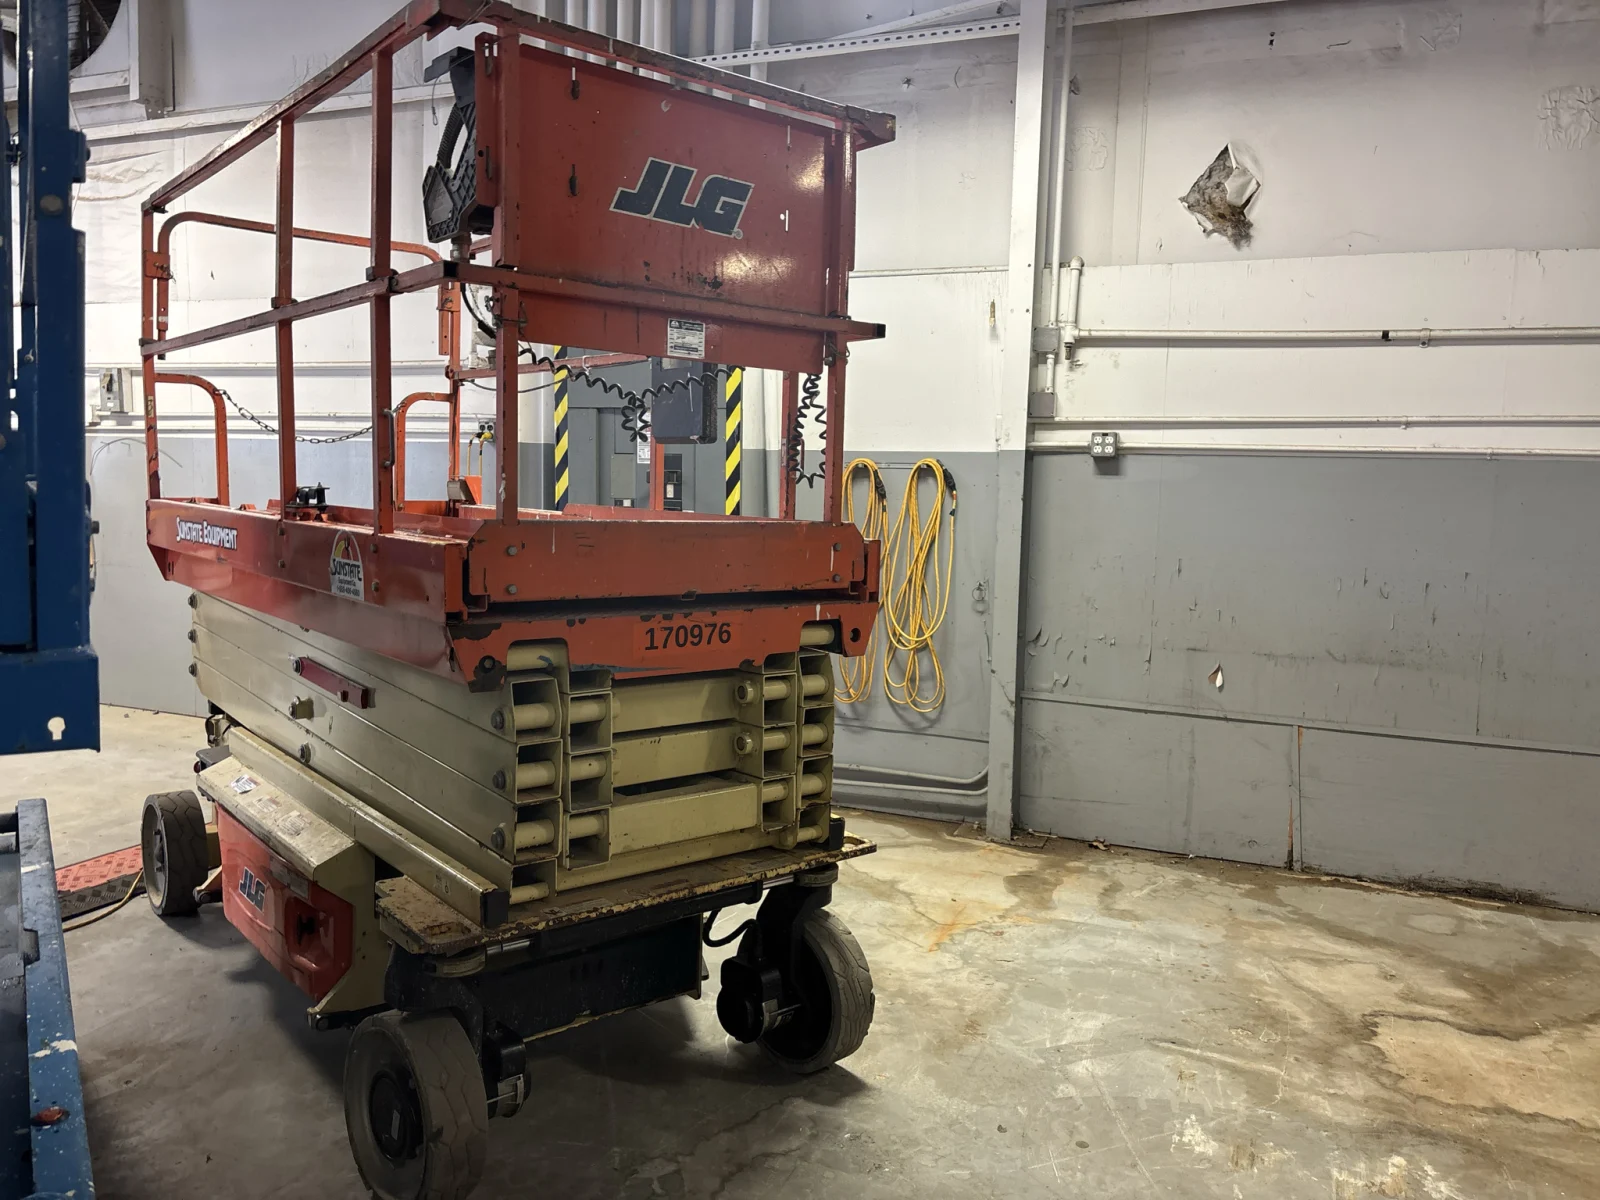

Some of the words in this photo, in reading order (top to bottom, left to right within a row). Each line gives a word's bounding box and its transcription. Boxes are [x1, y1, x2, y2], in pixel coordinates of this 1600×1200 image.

[609, 157, 755, 238] JLG
[331, 558, 362, 581] SUNSTATE
[645, 623, 731, 651] 170976
[239, 867, 266, 913] JLG
